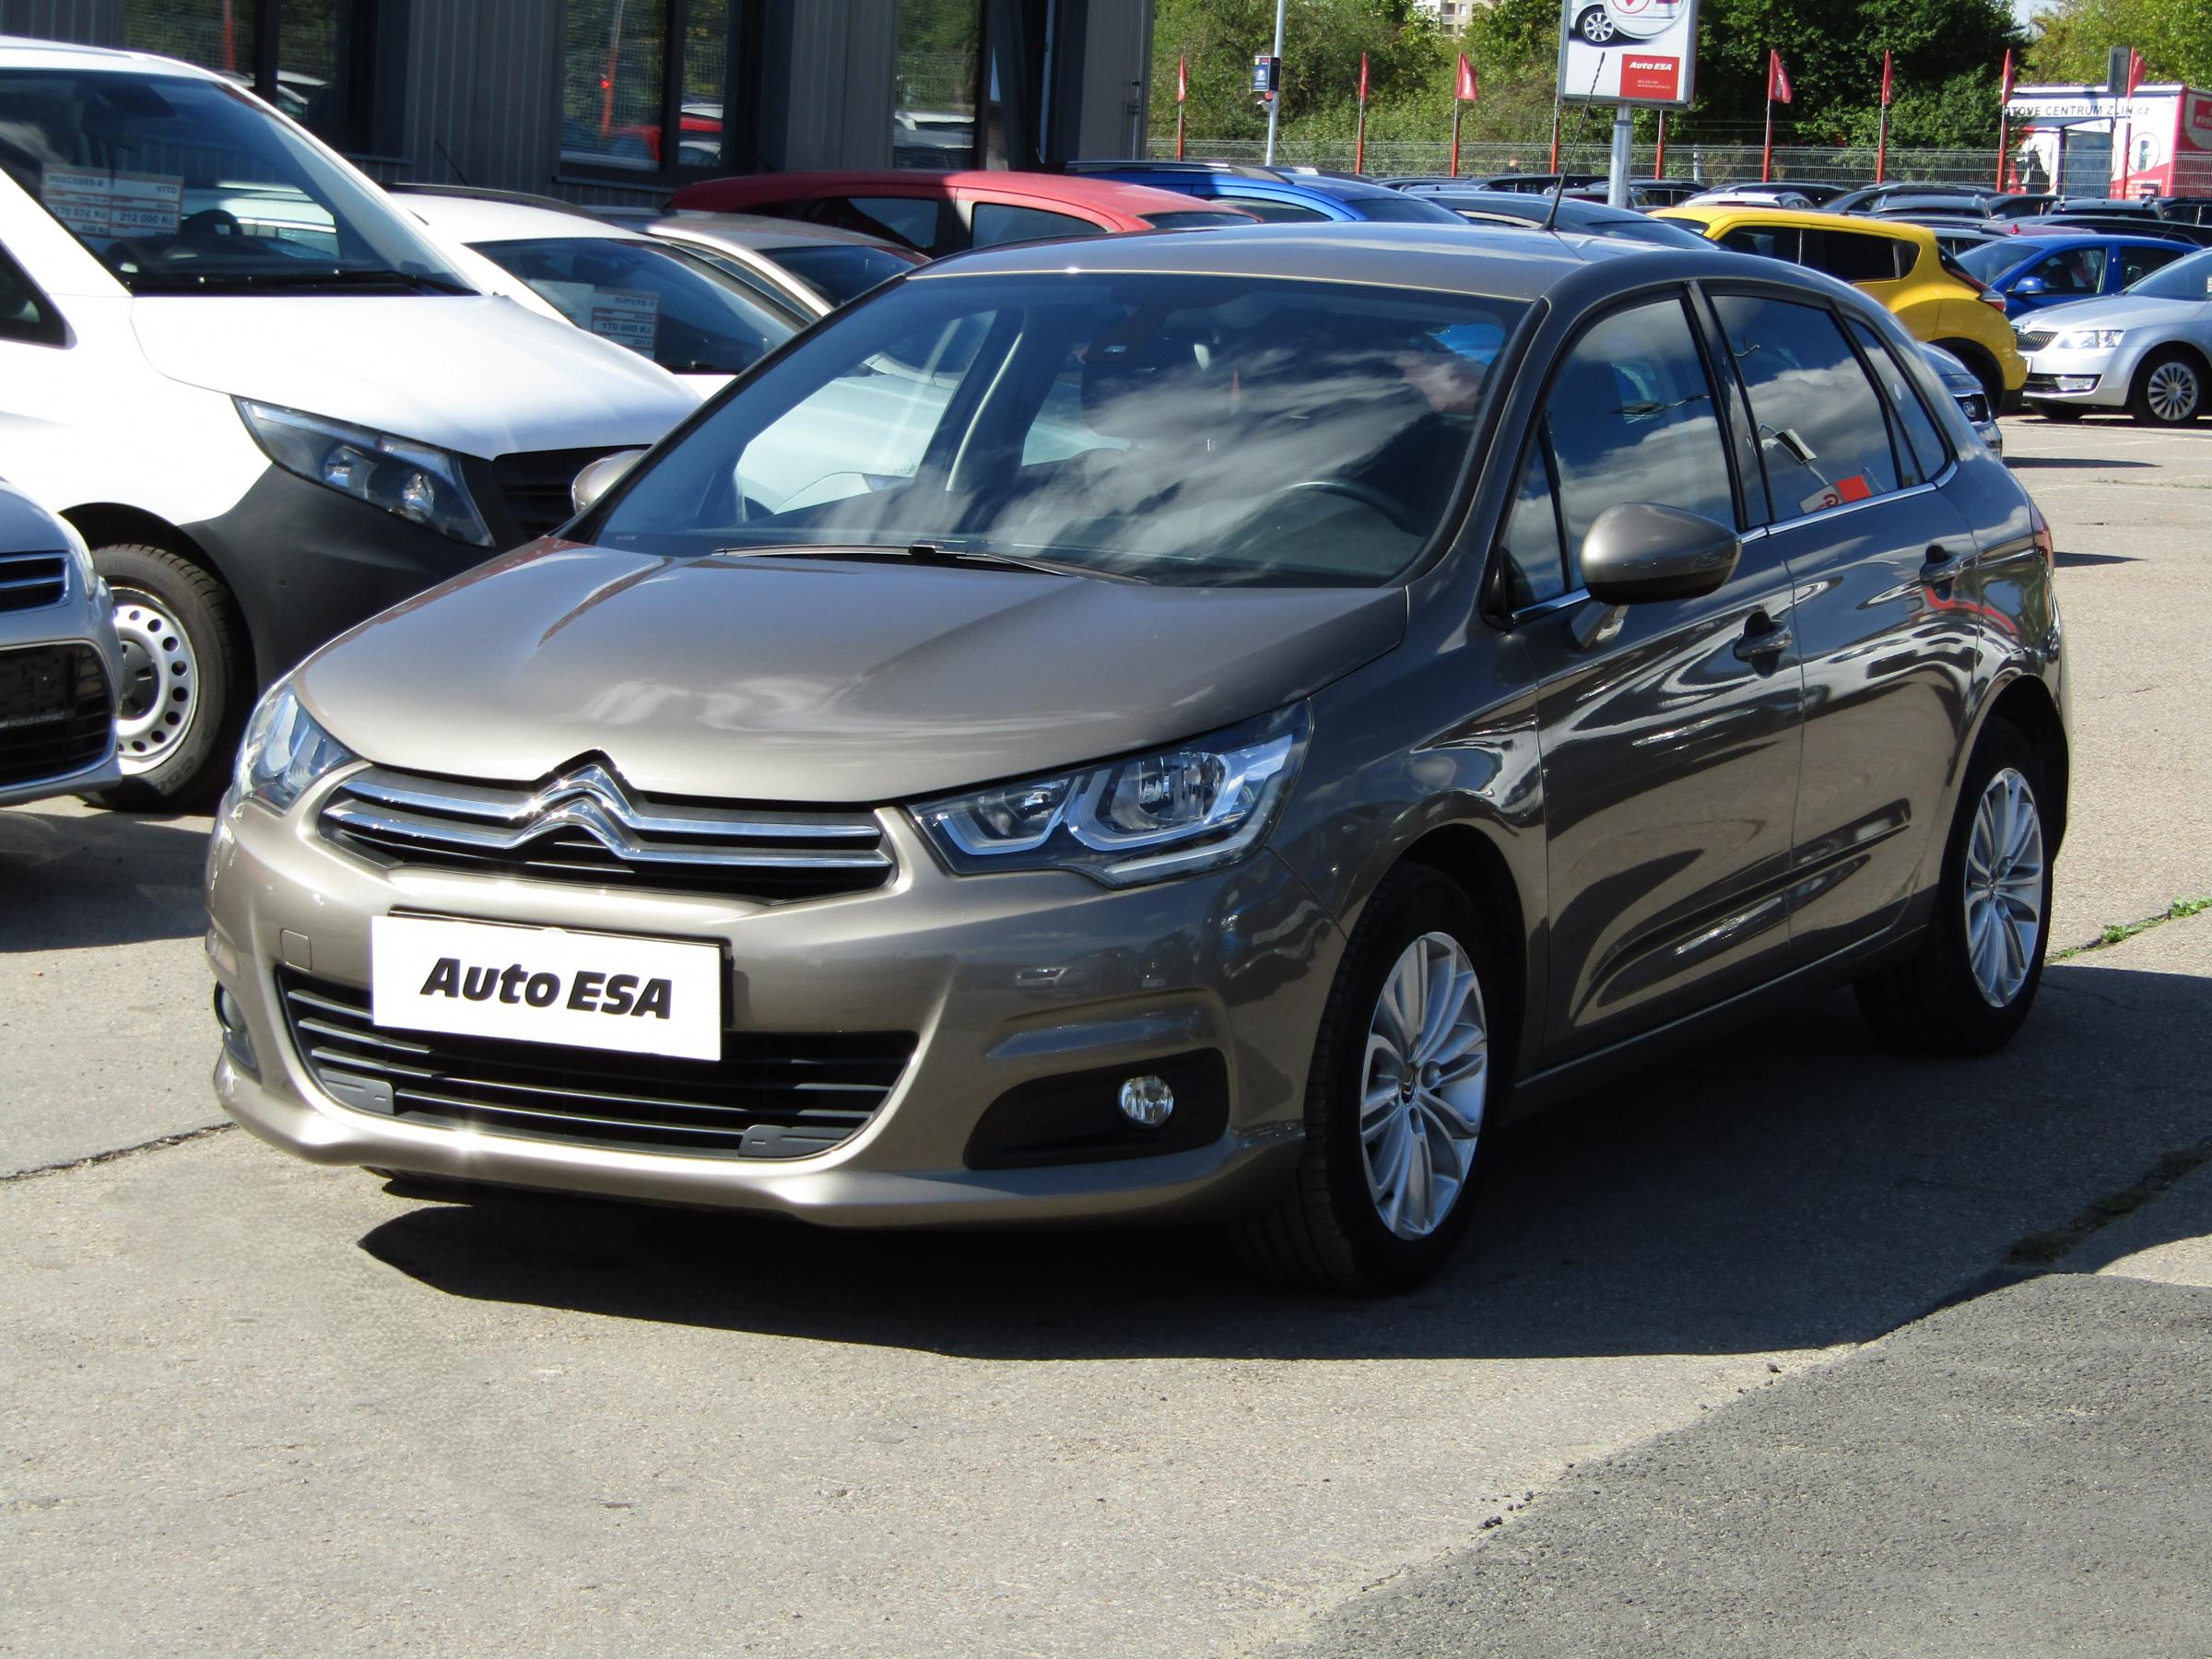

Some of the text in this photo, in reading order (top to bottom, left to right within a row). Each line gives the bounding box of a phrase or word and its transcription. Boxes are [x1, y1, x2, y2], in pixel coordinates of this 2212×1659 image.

[1629, 61, 1673, 71] Auto ESA
[2046, 105, 2103, 116] CENTRUM
[156, 185, 178, 194] VITO
[615, 296, 648, 306] SUPERB
[602, 322, 618, 331] 170
[620, 324, 638, 332] 000
[419, 957, 673, 1020] Auto ESA
